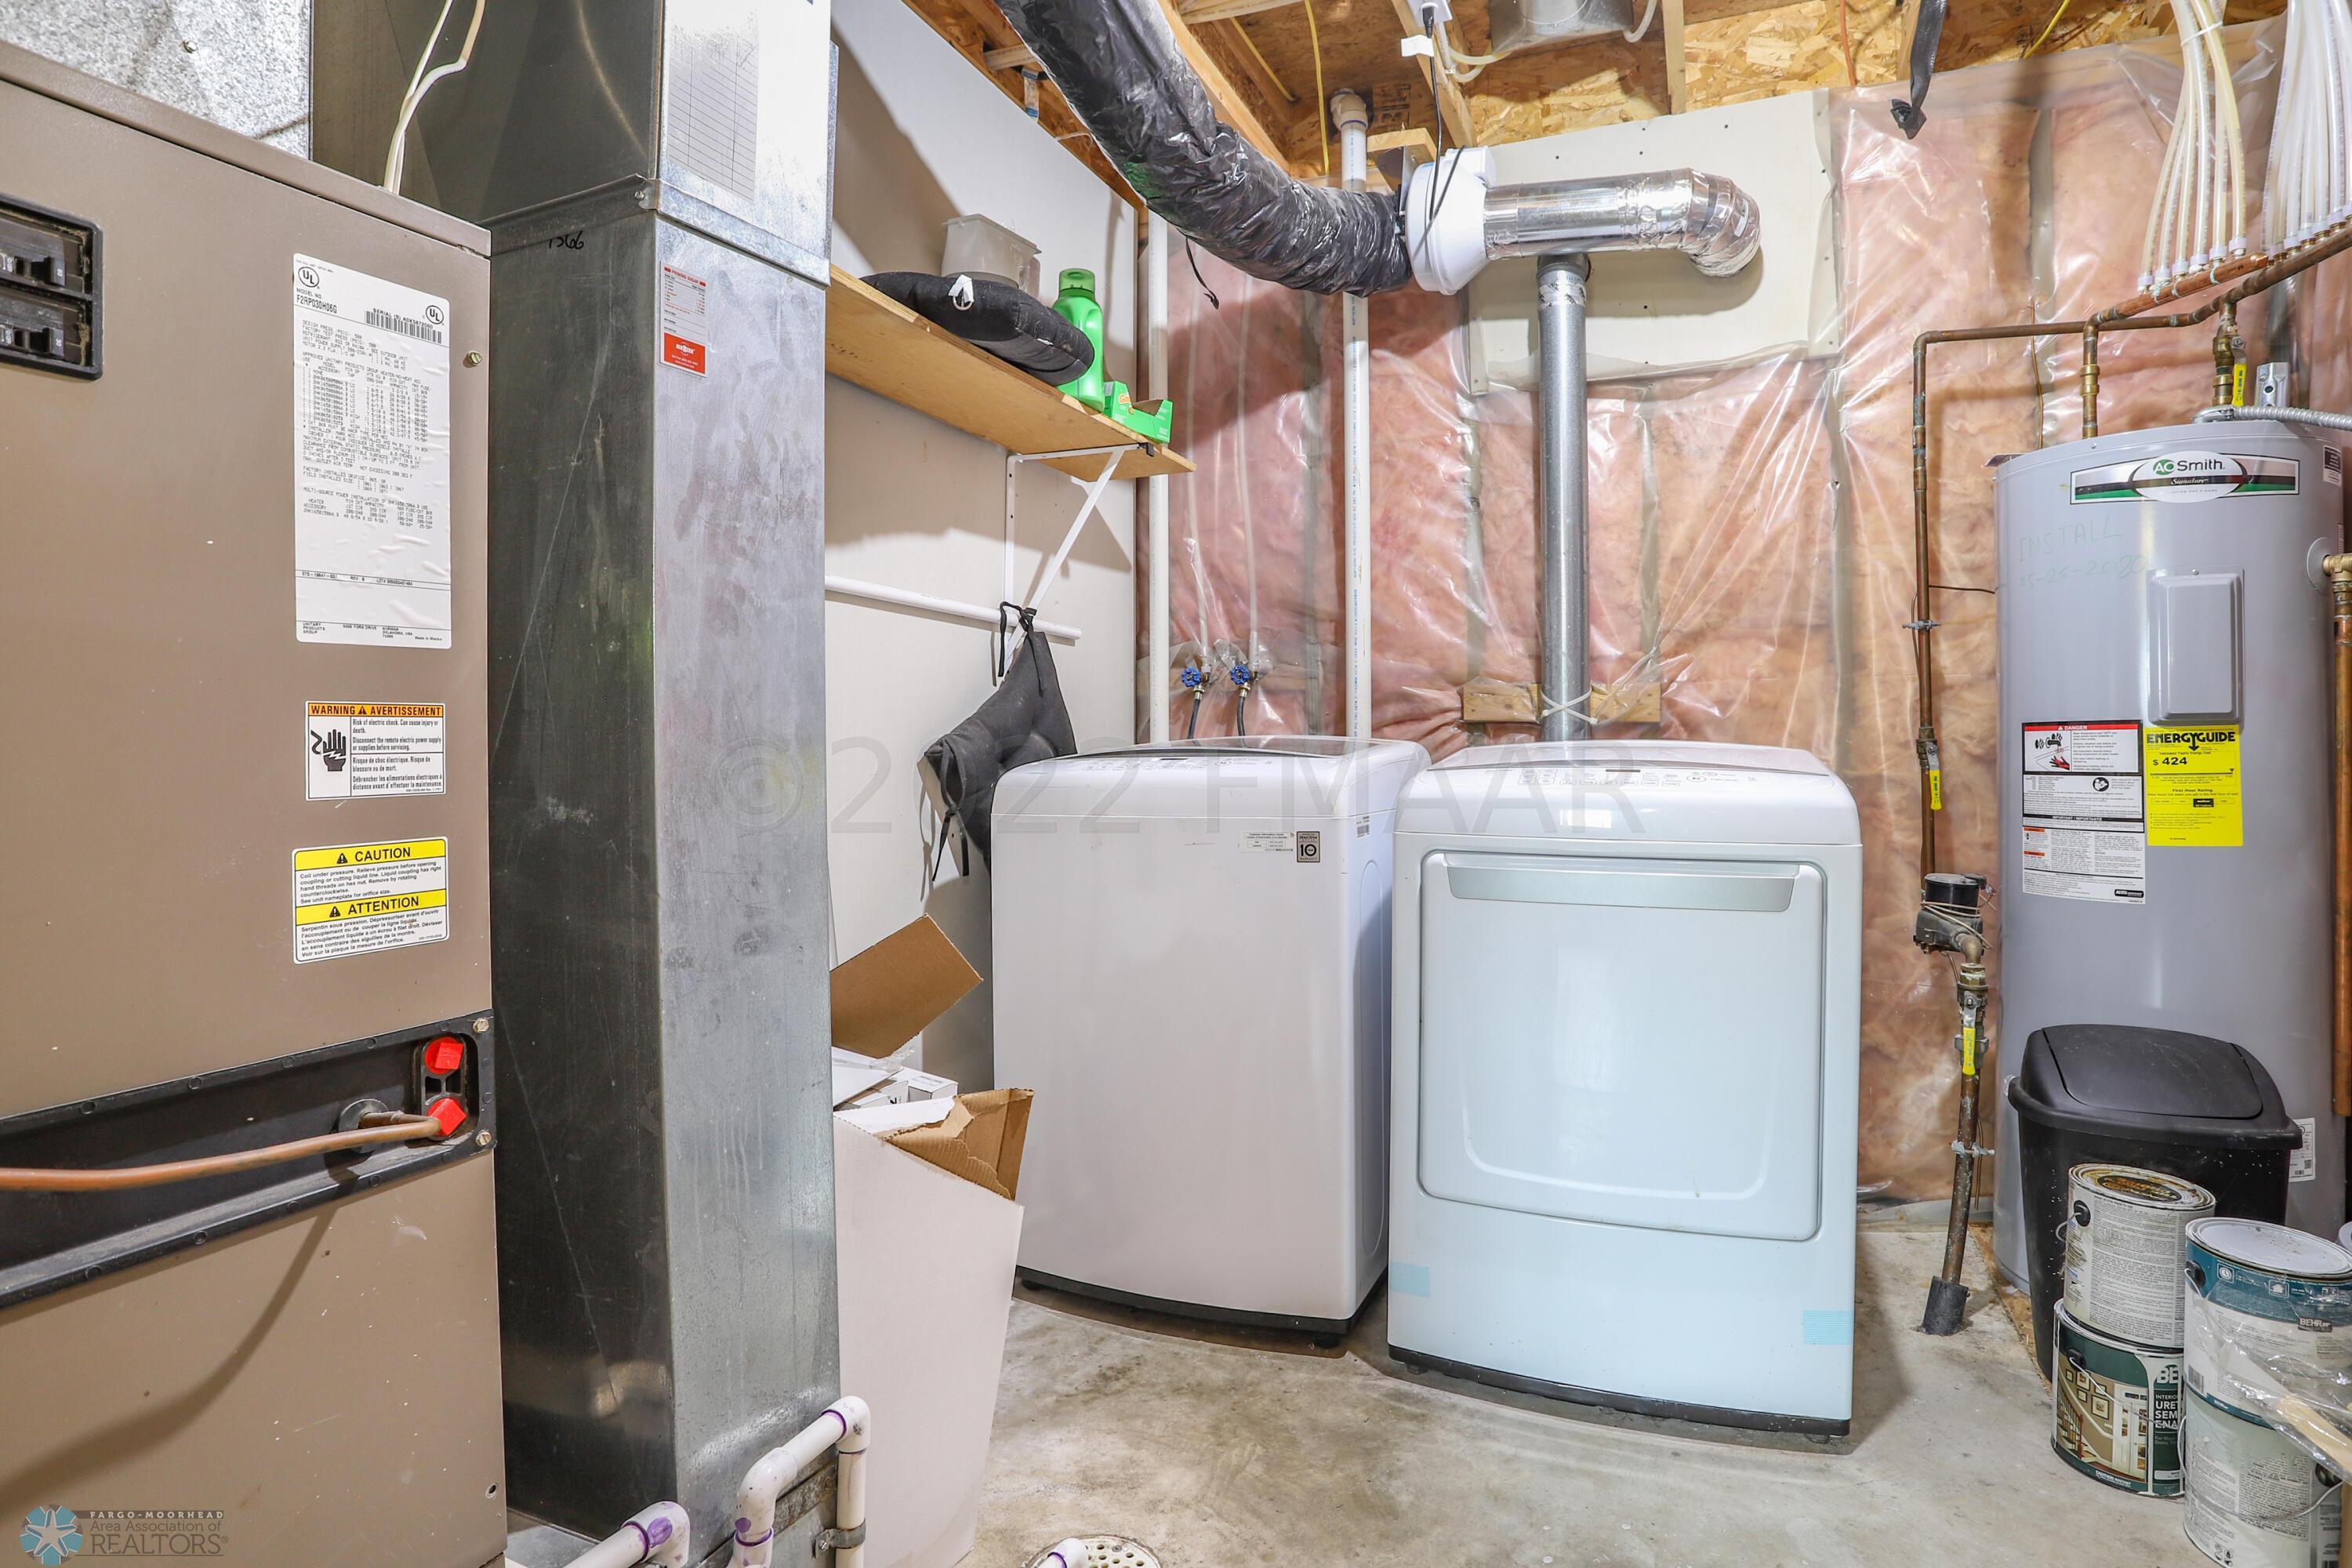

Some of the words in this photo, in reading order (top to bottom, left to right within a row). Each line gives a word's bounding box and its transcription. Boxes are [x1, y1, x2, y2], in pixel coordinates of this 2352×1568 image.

[2177, 459, 2223, 471] Smith
[2020, 514, 2123, 562] INSTALL
[310, 706, 355, 715] WARNING
[370, 706, 441, 716] AVERTISSEMENT
[2147, 731, 2236, 745] ENERGYGUIDE
[354, 847, 411, 862] CAUTION
[1300, 844, 1317, 857] 10
[347, 896, 419, 916] ATTENTION
[2300, 1318, 2322, 1327] BEHR
